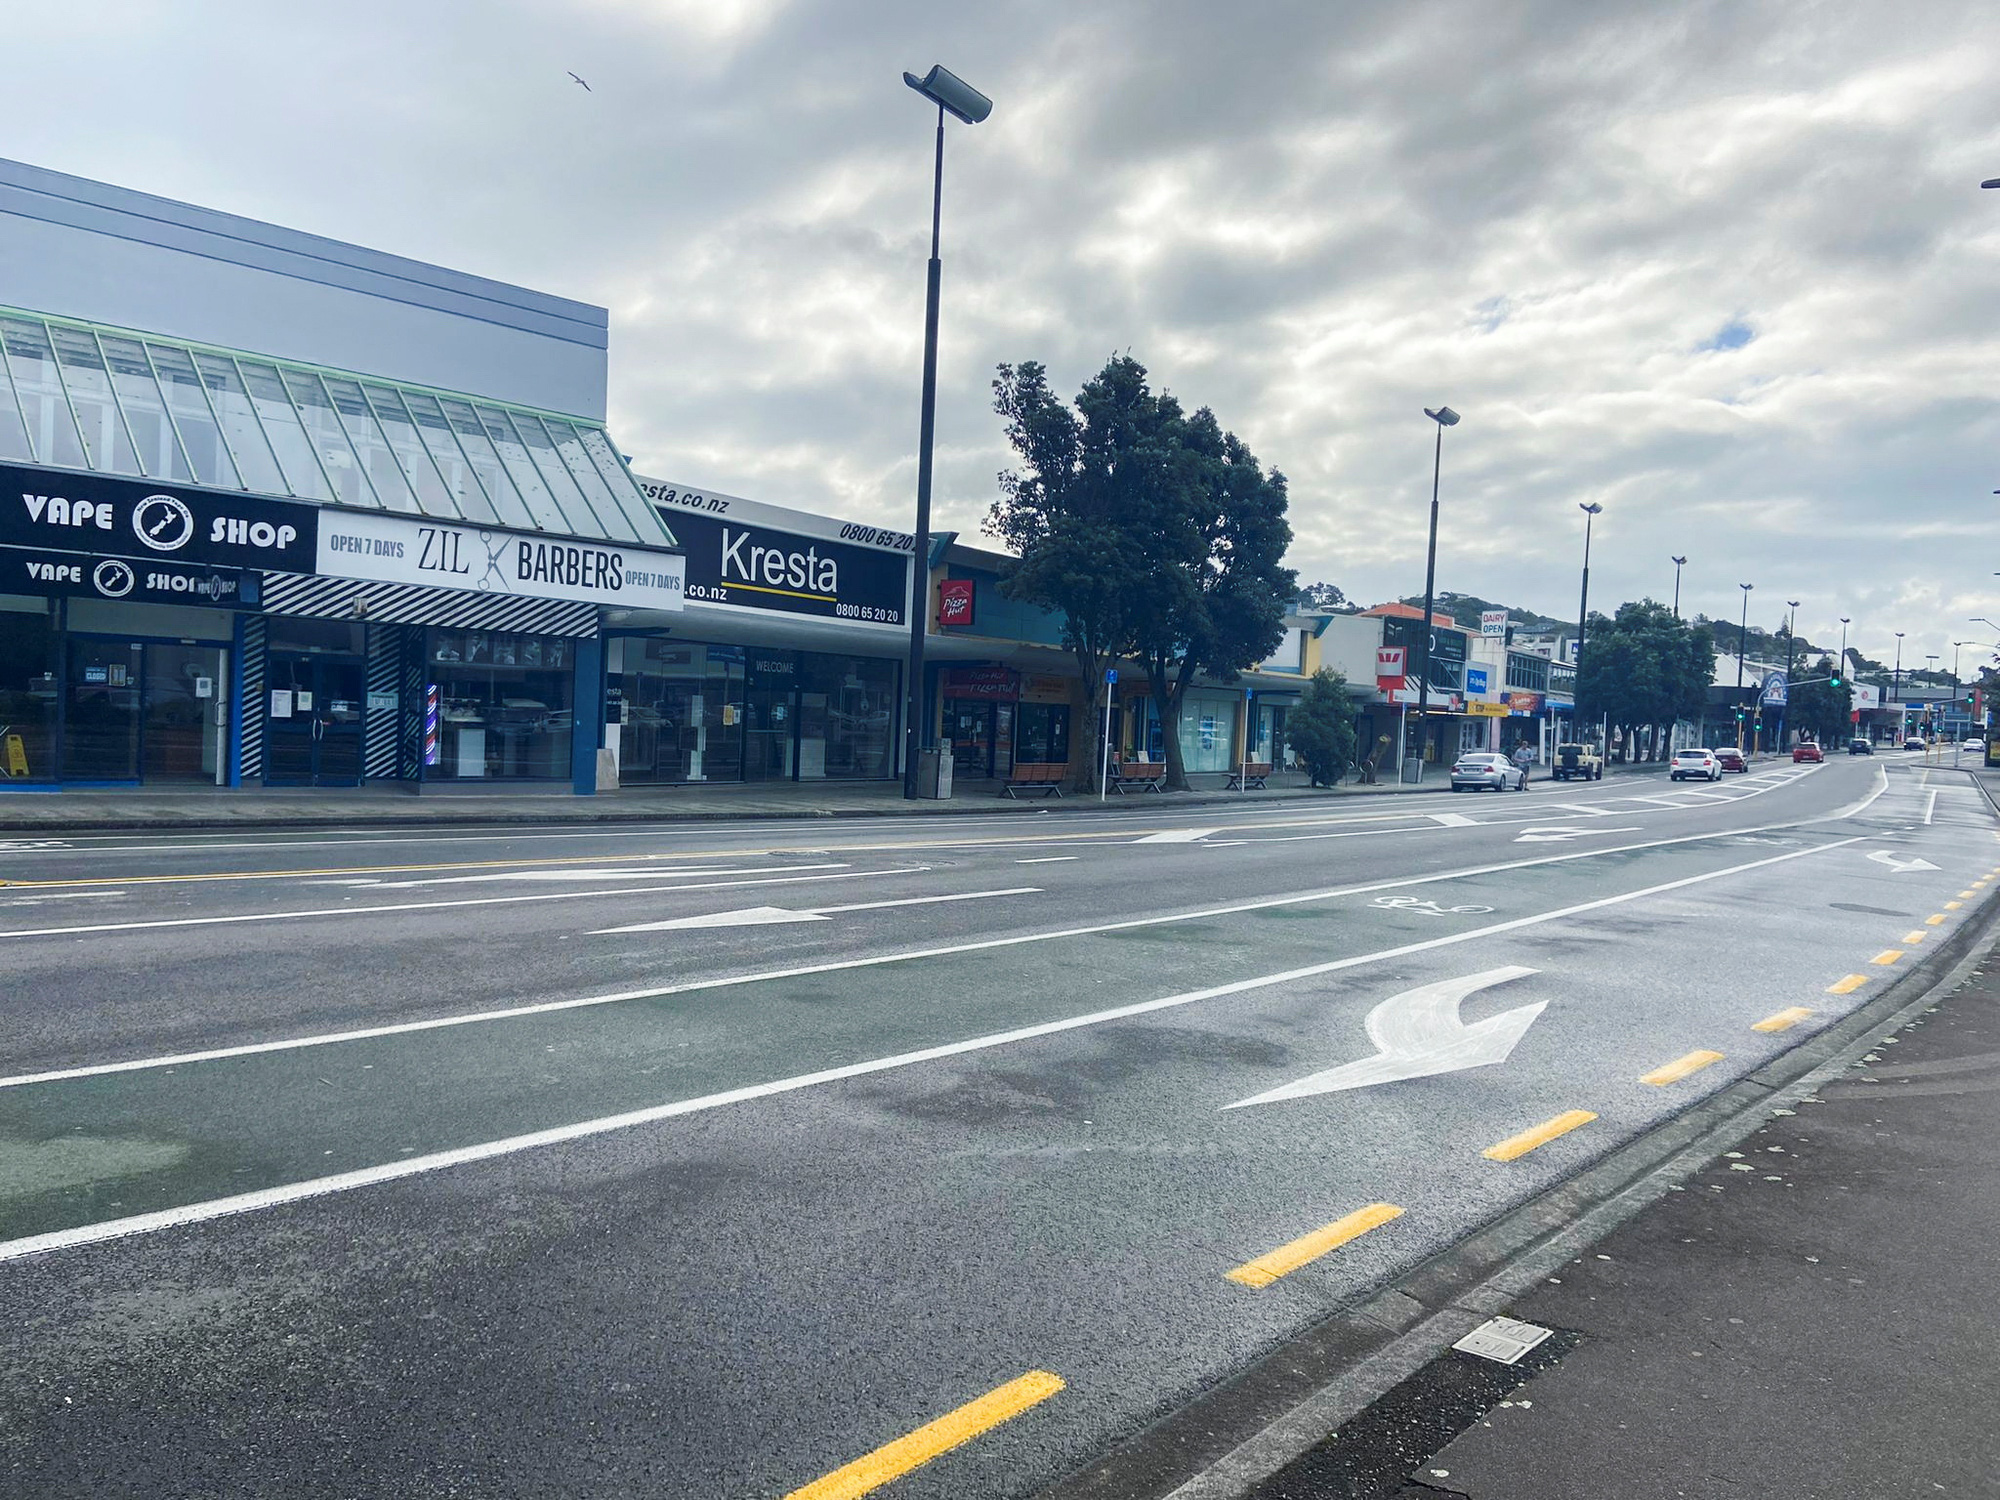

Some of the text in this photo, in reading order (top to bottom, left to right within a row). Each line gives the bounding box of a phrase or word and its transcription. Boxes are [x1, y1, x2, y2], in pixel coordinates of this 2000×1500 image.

[22, 494, 113, 530] VAPE
[210, 516, 297, 550] SHOP
[330, 533, 405, 559] OPEN 7 DAYS
[840, 524, 876, 543] 0800
[876, 531, 896, 546] 65
[893, 535, 913, 550] 20
[417, 527, 623, 592] ZIL BARBERS
[721, 528, 837, 593] Kresta
[26, 561, 81, 583] VAPE
[625, 569, 681, 591] OPEN 7 DAYS
[836, 603, 899, 623] 0800 65 20 20
[942, 598, 968, 610] Pizza
[947, 606, 965, 617] Hut
[1483, 614, 1505, 623] DAIRY
[1483, 624, 1504, 633] OPEN
[756, 660, 794, 674] WELCOME
